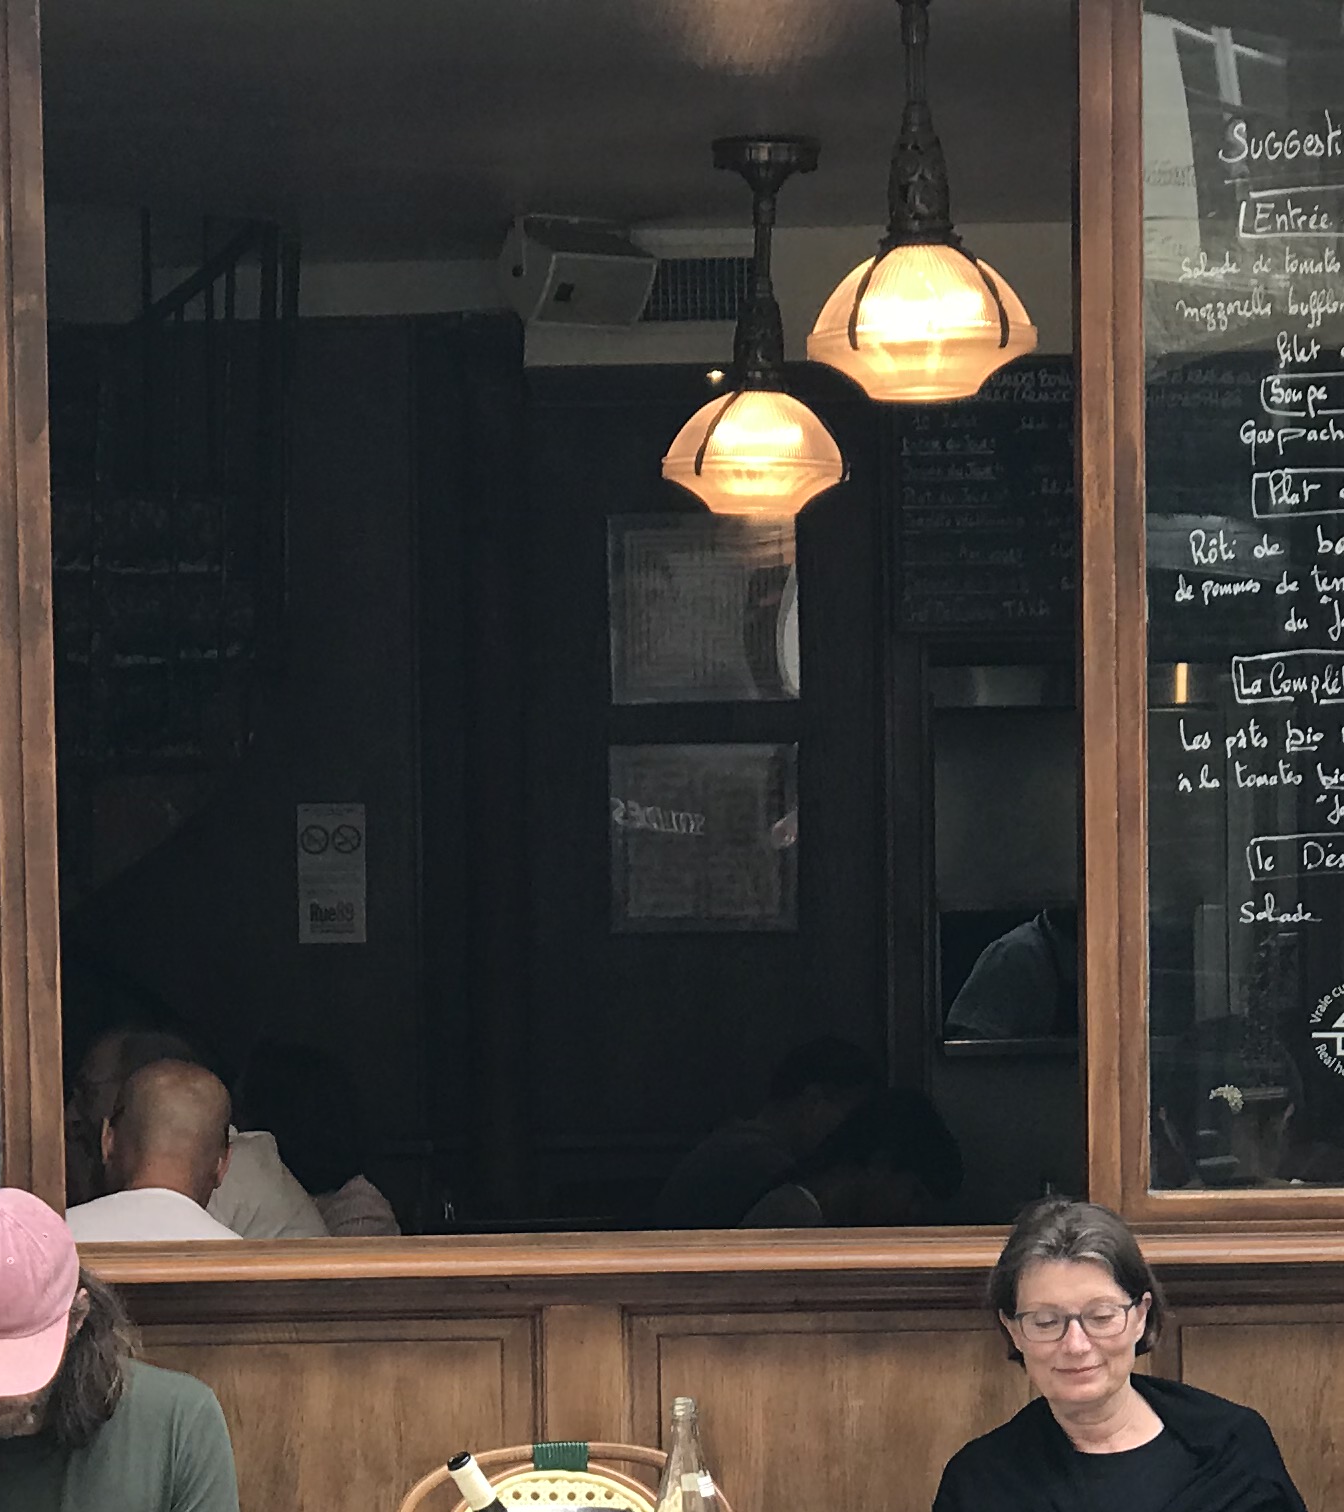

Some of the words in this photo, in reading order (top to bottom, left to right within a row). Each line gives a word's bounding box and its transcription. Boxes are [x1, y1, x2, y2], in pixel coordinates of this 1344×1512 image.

[1254, 202, 1333, 232] Entrée
[1268, 469, 1321, 506] Plat
[1253, 533, 1285, 559] de
[1275, 570, 1300, 595] de
[1284, 607, 1309, 633] du
[1309, 995, 1333, 1024] Vraie
[1315, 1043, 1337, 1069] Real
